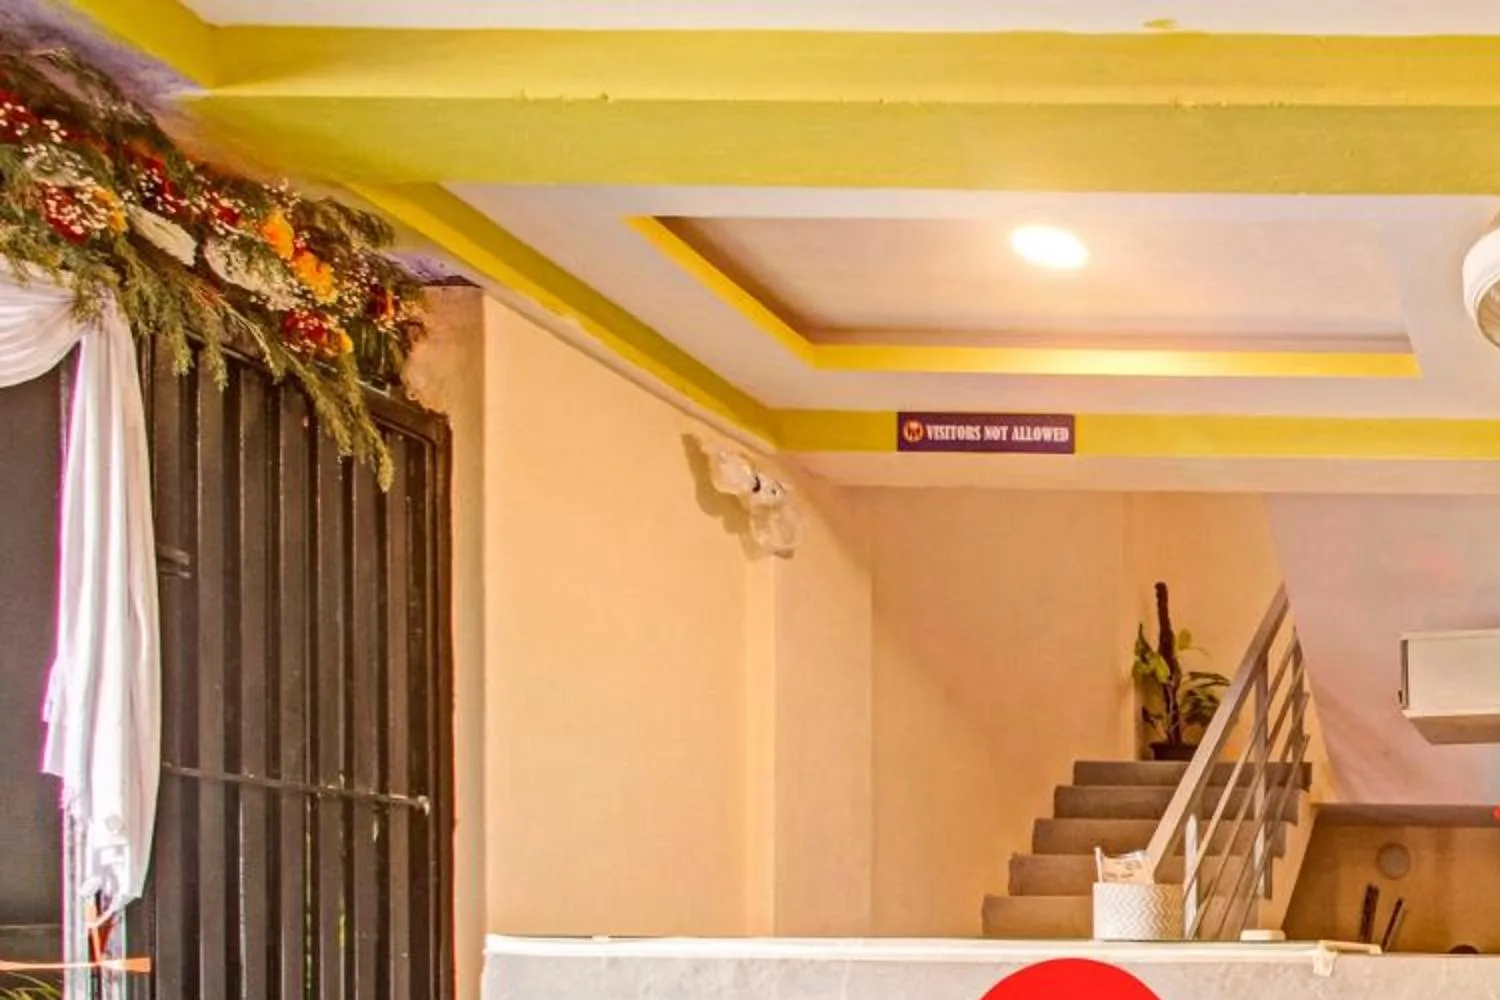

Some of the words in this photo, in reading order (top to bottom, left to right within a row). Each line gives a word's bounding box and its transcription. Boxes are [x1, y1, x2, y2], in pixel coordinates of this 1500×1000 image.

[926, 424, 981, 441] VISITORS
[983, 425, 1008, 441] NOT
[1012, 426, 1069, 442] ALLOWED
